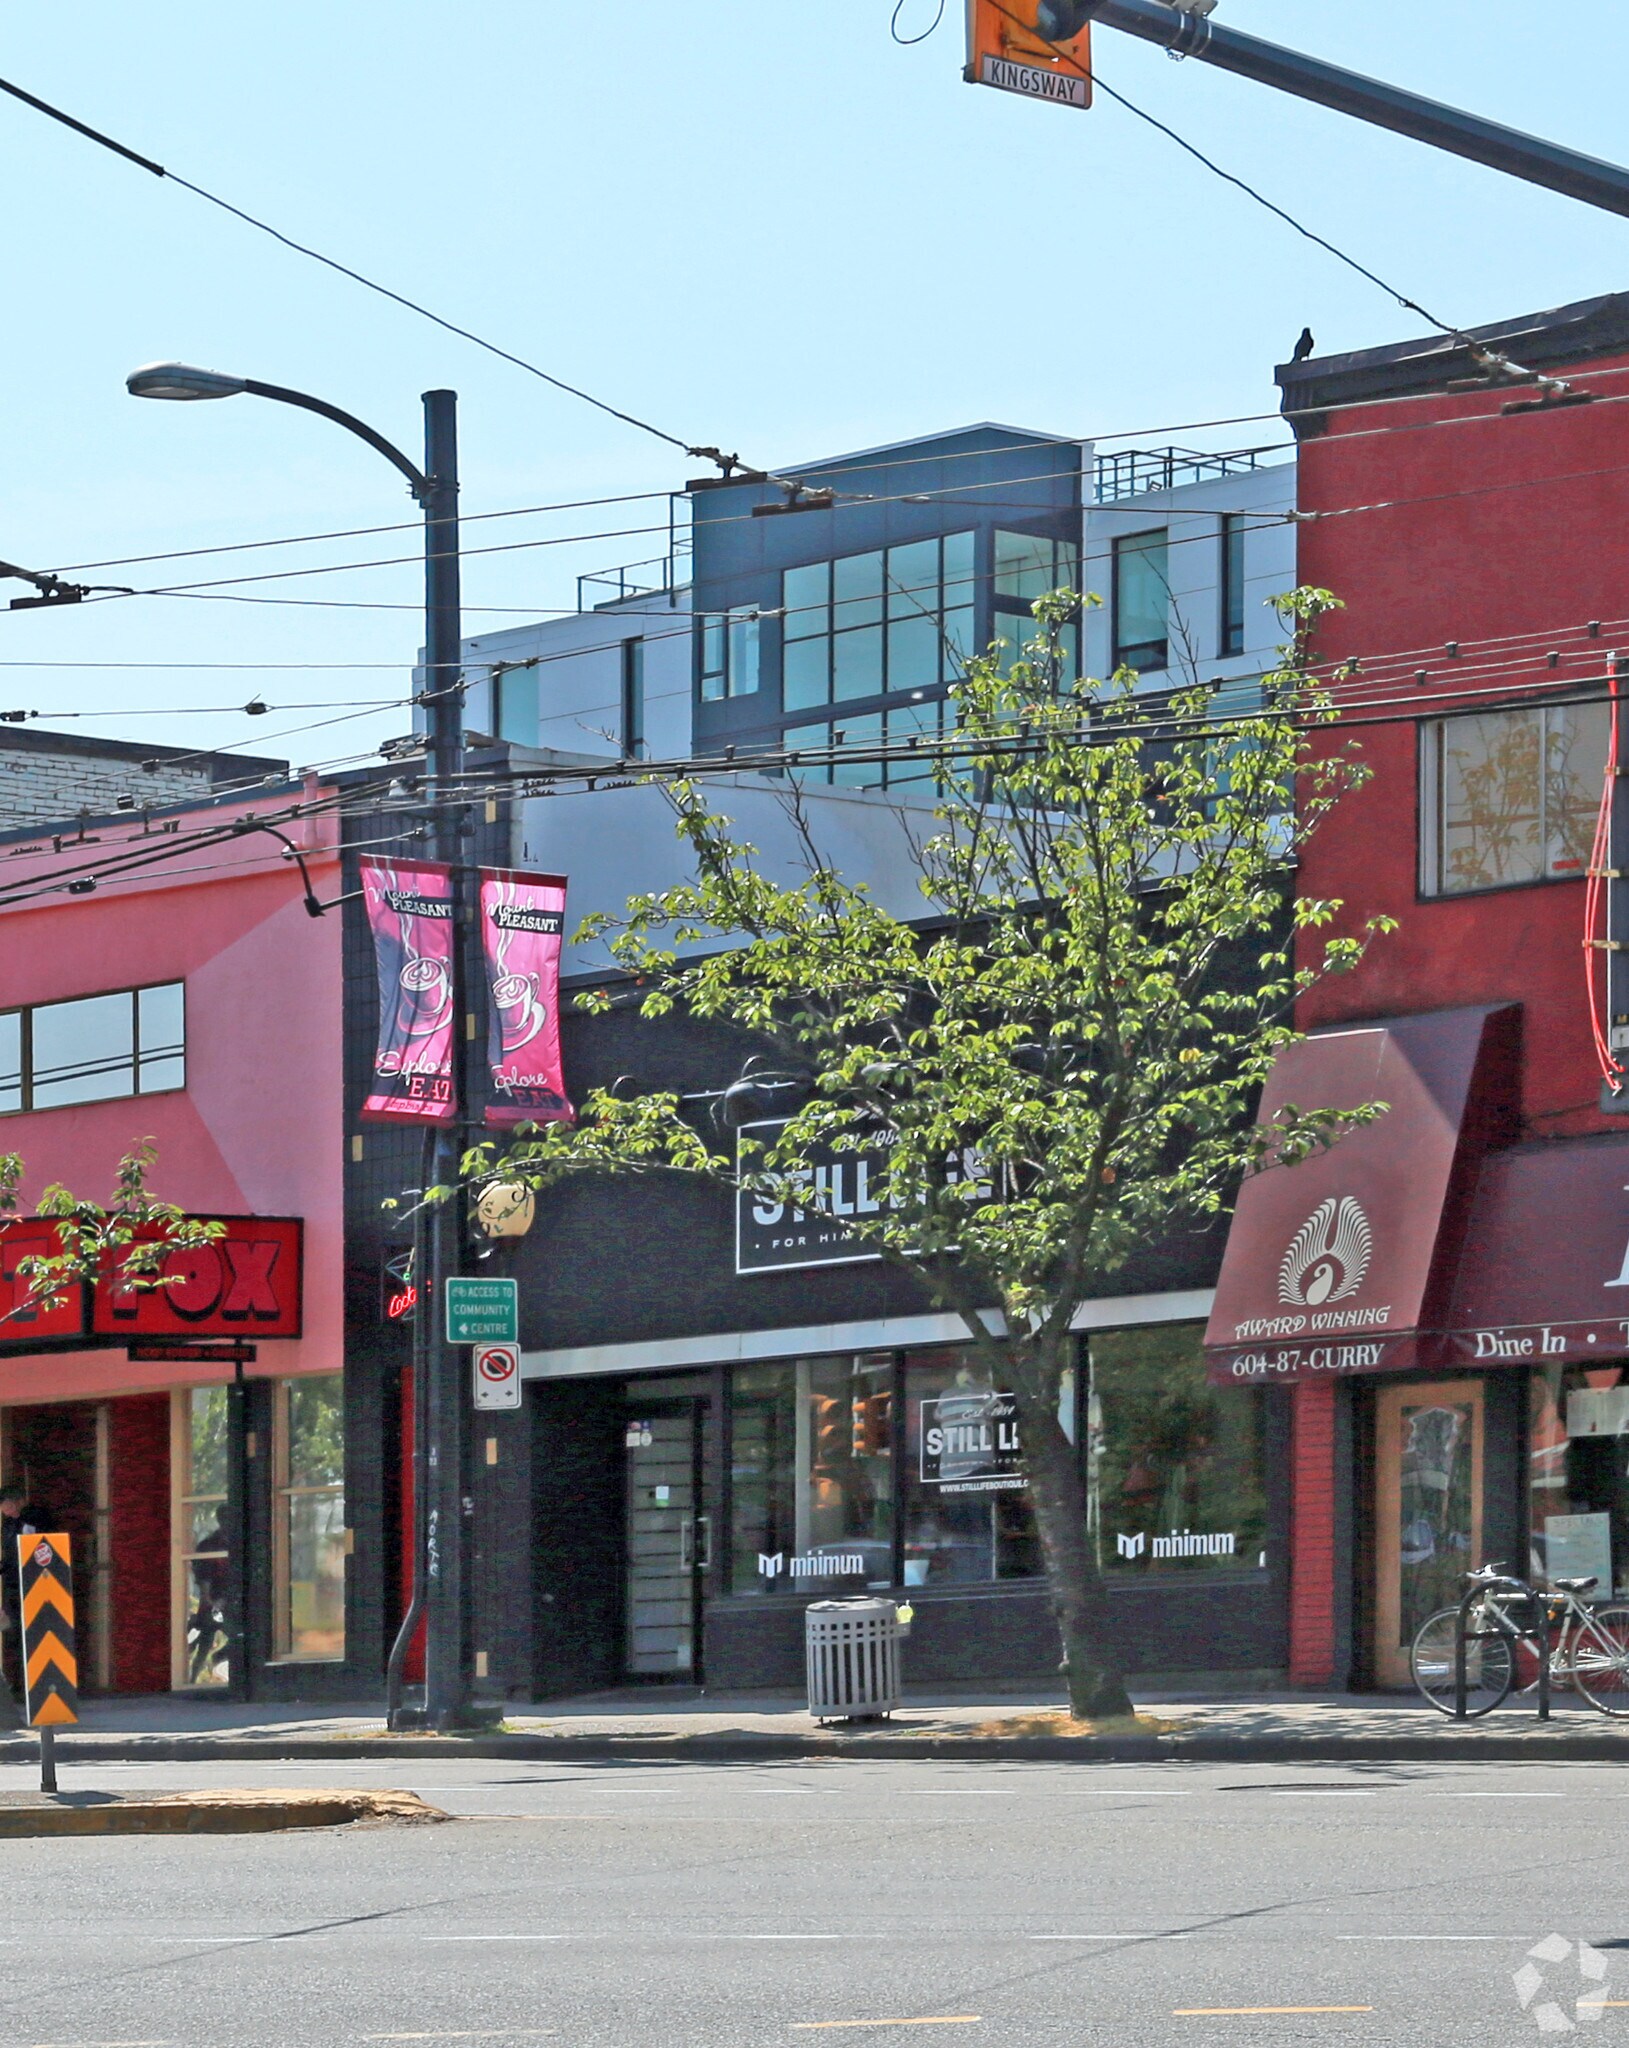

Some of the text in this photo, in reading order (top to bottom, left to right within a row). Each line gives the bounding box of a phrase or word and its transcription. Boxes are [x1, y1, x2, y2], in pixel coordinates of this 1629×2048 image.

[991, 60, 1076, 100] KINGSWAY
[369, 884, 422, 903] Mount
[486, 895, 535, 918] Mount
[392, 900, 452, 917] PLEASANT
[498, 916, 558, 932] PLEASANT
[376, 1050, 452, 1086] Exploe
[486, 1064, 548, 1097] Eplore
[752, 1160, 880, 1226] STILL
[772, 1236, 807, 1249] FOR
[111, 1238, 281, 1323] FOX
[467, 1286, 514, 1298] ACCESS TO
[453, 1304, 511, 1316] COMMUNITY
[1234, 1305, 1391, 1340] AWARD WINNING
[470, 1322, 509, 1335] CENTRE
[1474, 1326, 1567, 1358] Dine In
[1231, 1343, 1386, 1377] 604-87-CURRY
[926, 1421, 1019, 1456] STILL LI
[939, 1479, 1029, 1494] WWW.STILLLIFEBOUTIQUE.C
